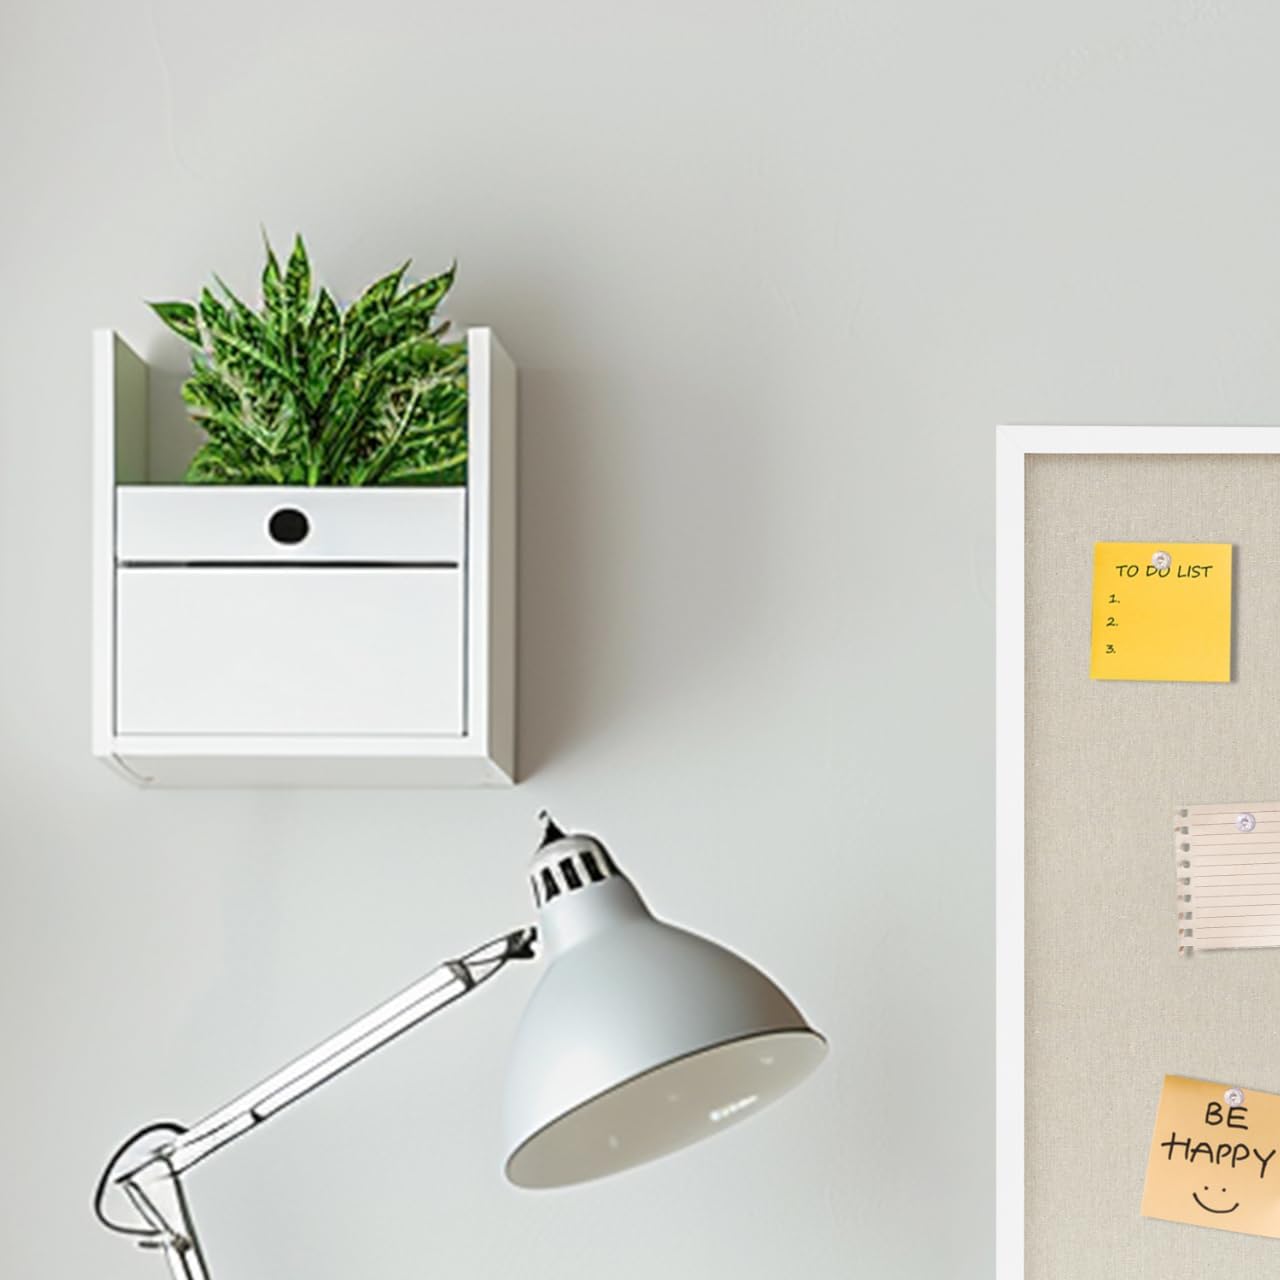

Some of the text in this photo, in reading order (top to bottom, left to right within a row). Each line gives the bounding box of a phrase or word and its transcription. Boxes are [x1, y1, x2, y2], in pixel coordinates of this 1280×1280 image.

[1115, 565, 1213, 578] TO DO LIST
[1108, 594, 1121, 604] 1.
[1105, 617, 1119, 627] 2.
[1105, 644, 1116, 654] 3.
[1205, 1101, 1249, 1130] BE
[1160, 1132, 1277, 1179] HAPPY
